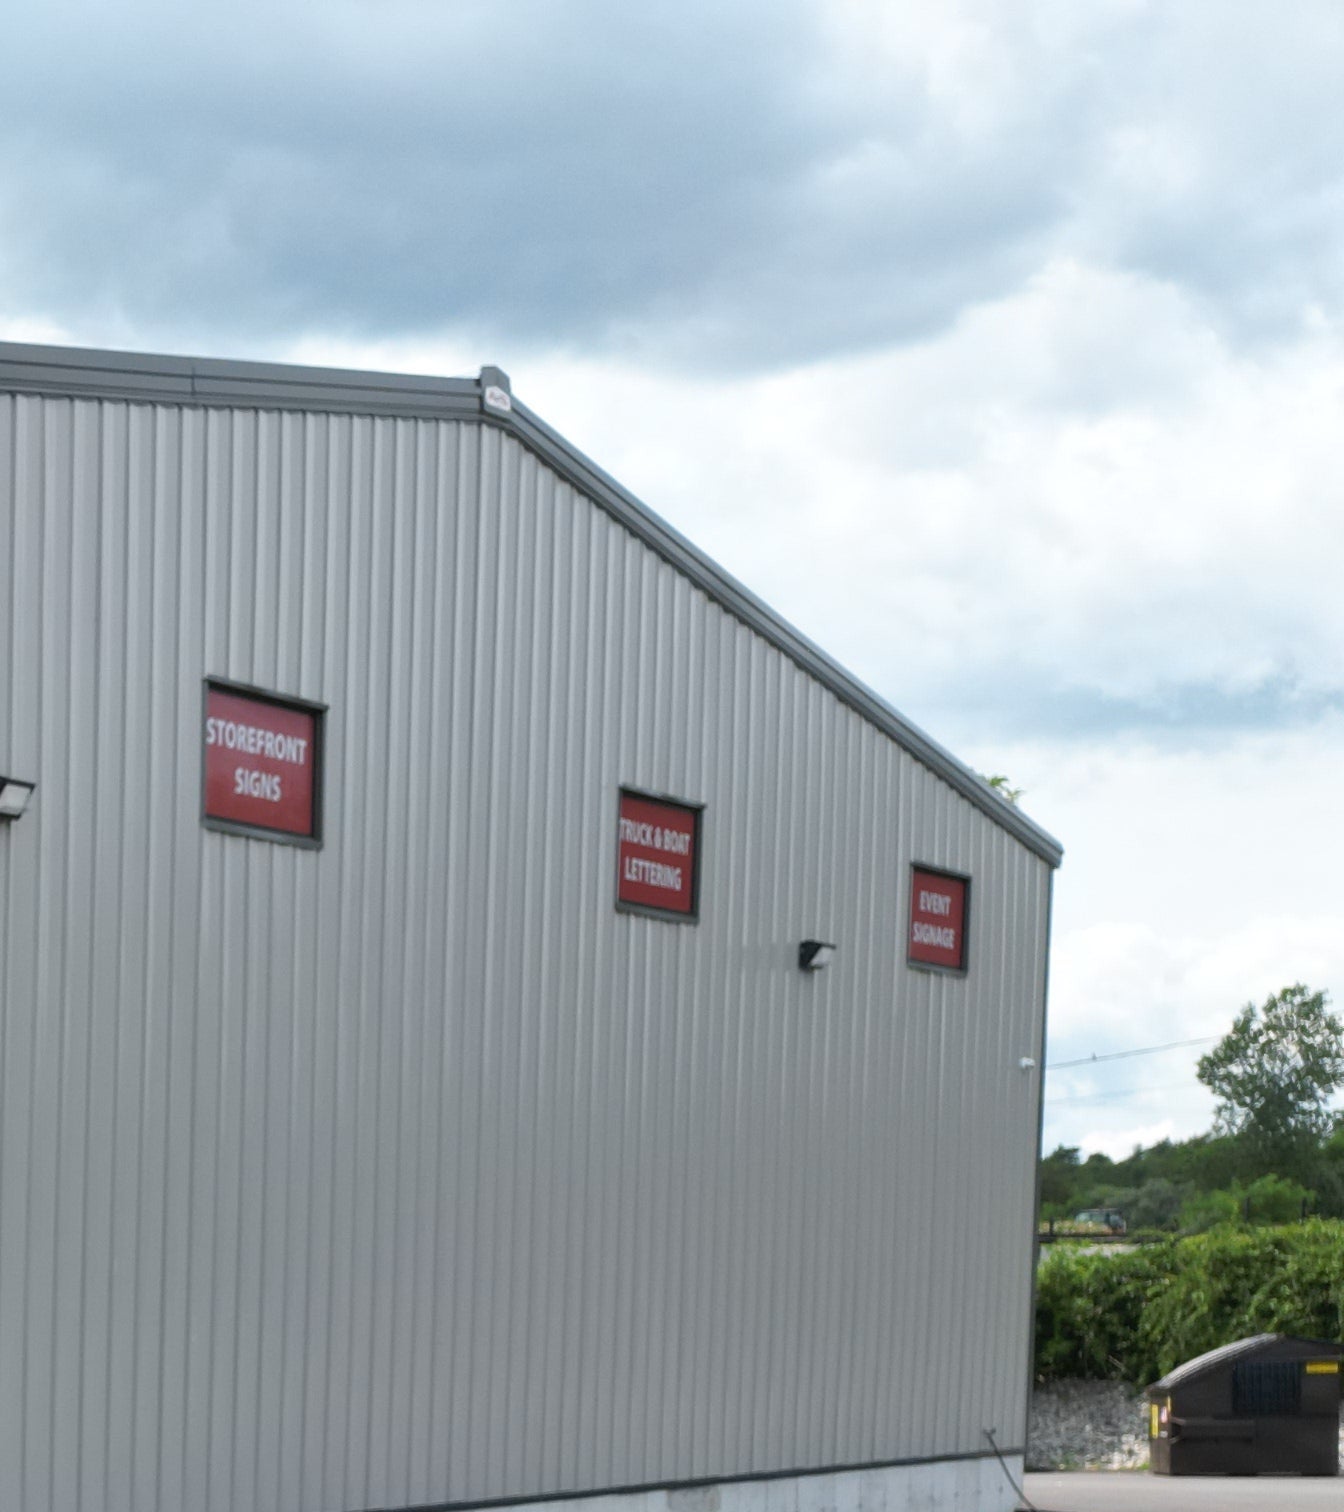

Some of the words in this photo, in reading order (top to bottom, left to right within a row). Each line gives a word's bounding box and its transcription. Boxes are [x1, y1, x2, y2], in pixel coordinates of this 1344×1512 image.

[206, 718, 307, 764] STOREFRONT
[234, 767, 282, 802] SIGNS
[619, 817, 654, 846] TRUCK
[664, 828, 691, 856] BOAT
[624, 856, 682, 891] LETTERING
[919, 890, 951, 917] EVENT
[913, 921, 954, 950] SIGNAGE
